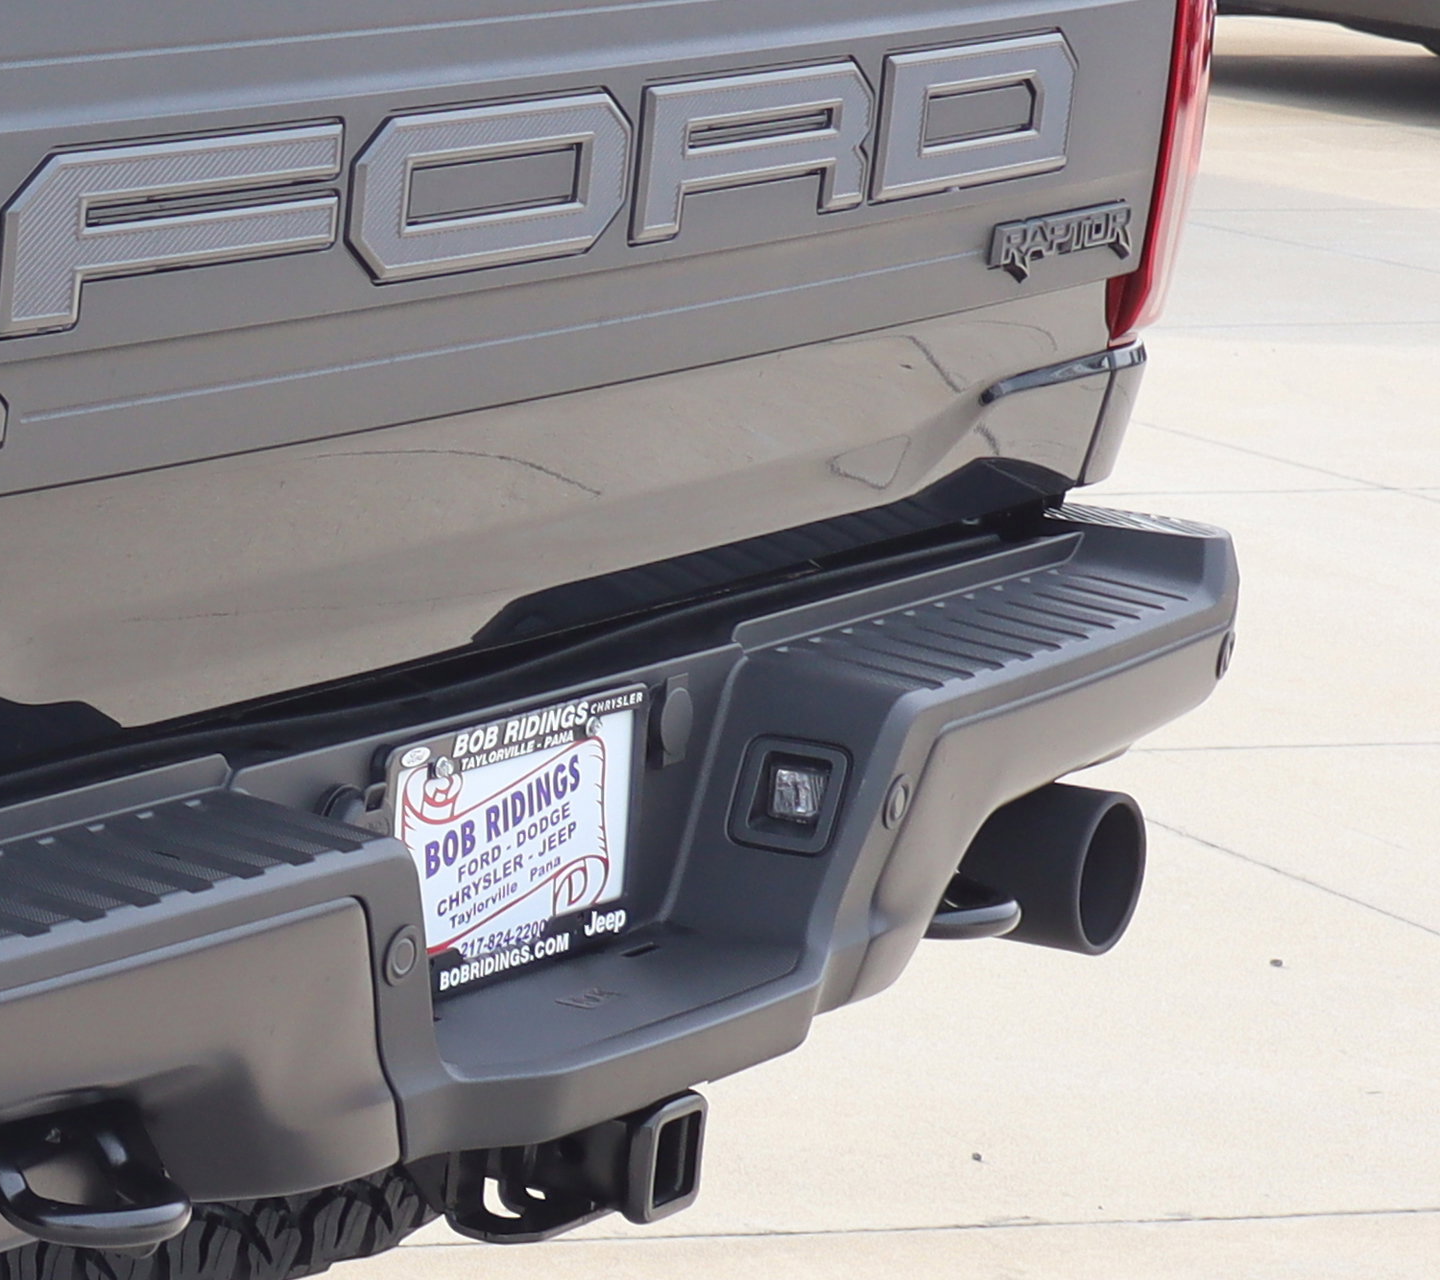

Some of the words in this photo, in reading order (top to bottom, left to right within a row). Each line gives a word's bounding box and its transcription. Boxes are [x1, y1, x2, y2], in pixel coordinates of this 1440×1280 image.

[992, 198, 1132, 282] RAPTOR
[452, 725, 499, 759] BOB
[503, 701, 589, 745] RIDINGS
[590, 691, 643, 715] CHRYSLER
[460, 738, 535, 771] TAYLORVILLE
[543, 729, 574, 748] PANA
[424, 818, 476, 880] BOB
[486, 753, 581, 843] RIDINGS
[457, 844, 502, 884] FORD
[517, 801, 571, 849] DODGE
[437, 849, 524, 917] CHRYSLER
[538, 820, 577, 858] JEEP
[449, 880, 518, 929] Taylorville
[530, 854, 562, 882] Pana
[460, 918, 547, 959] 217-824-2200
[584, 908, 626, 937] Jeep
[439, 932, 569, 991] BOBRIDINGS.COM
